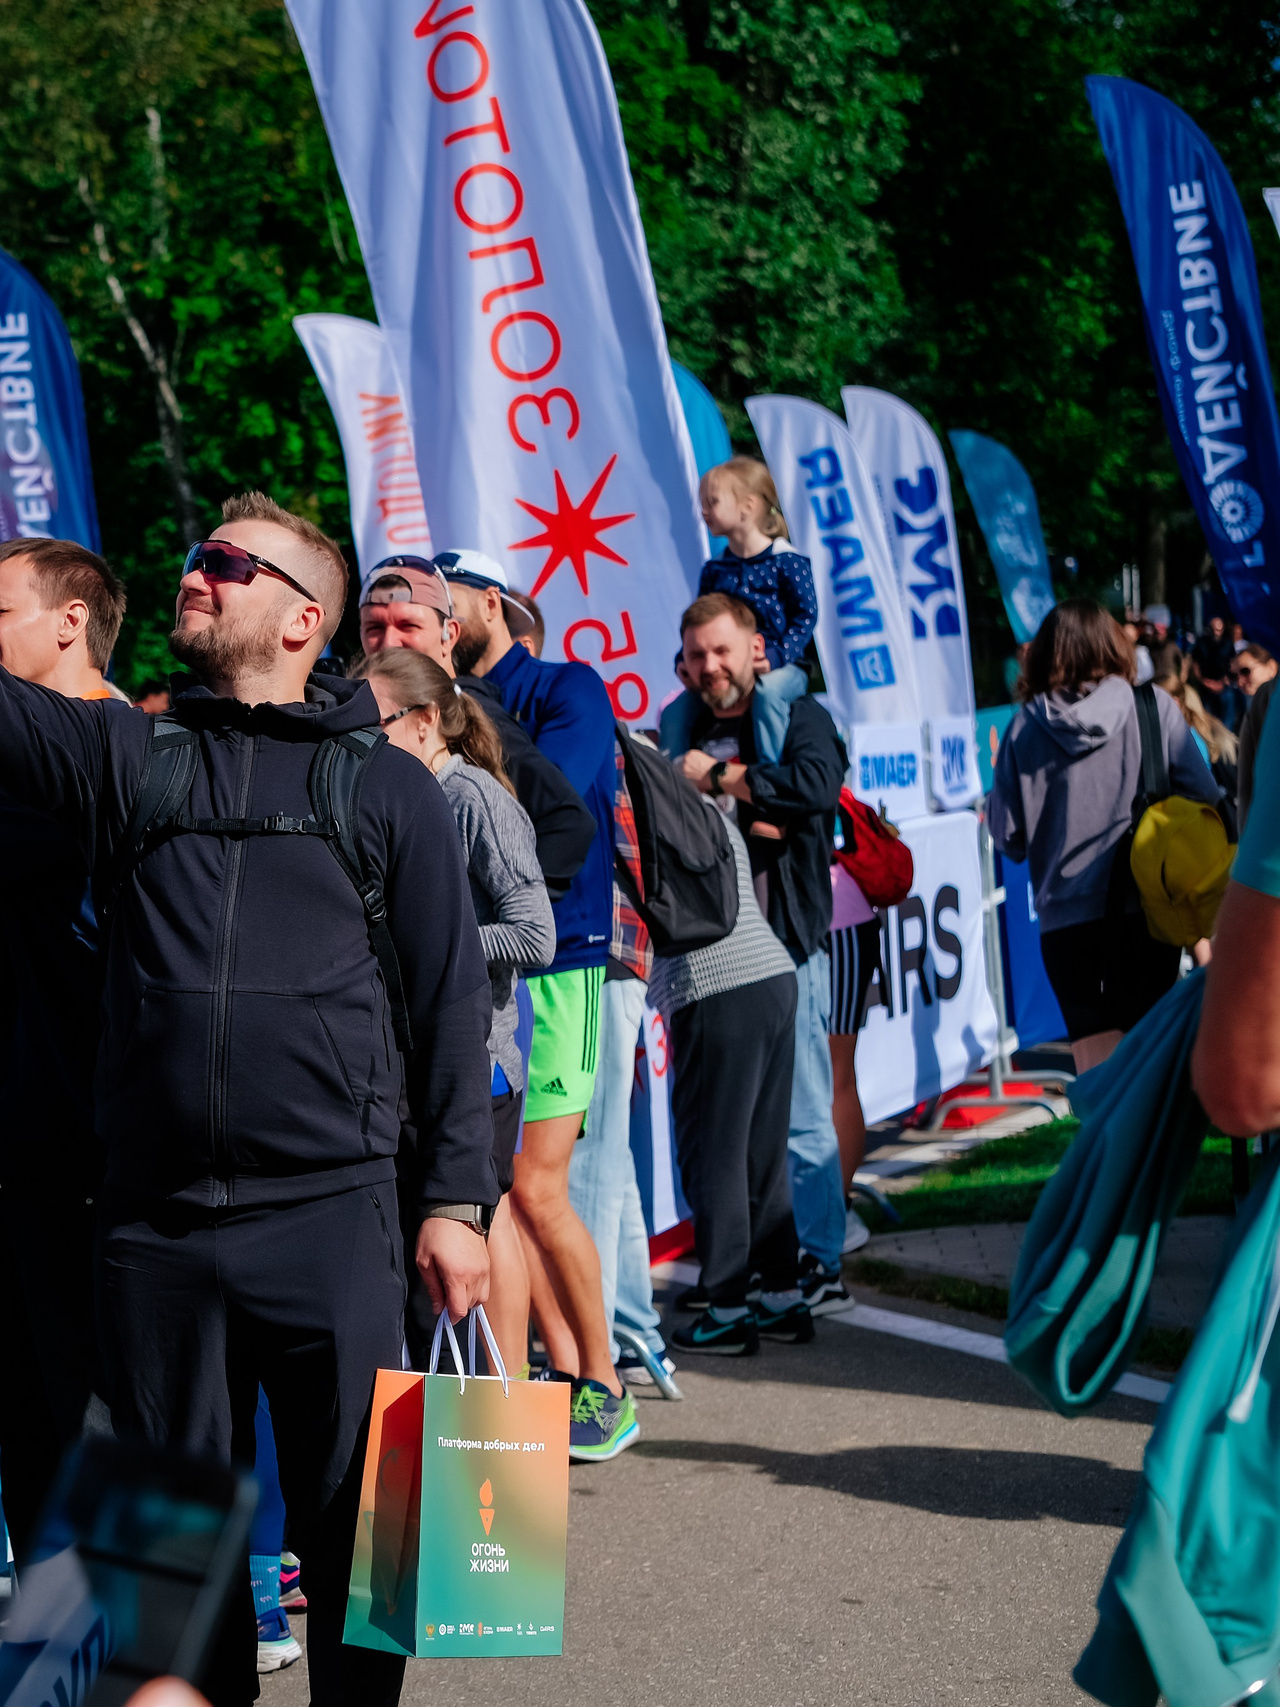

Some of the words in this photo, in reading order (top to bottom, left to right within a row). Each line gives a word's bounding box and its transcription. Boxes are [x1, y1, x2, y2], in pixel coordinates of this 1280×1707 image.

[437, 1436, 482, 1451] Платформа
[483, 1438, 520, 1452] добрых
[522, 1441, 545, 1452] дел
[471, 1542, 506, 1557] ОГОНЬ
[469, 1558, 510, 1573] ЖИЗНИ
